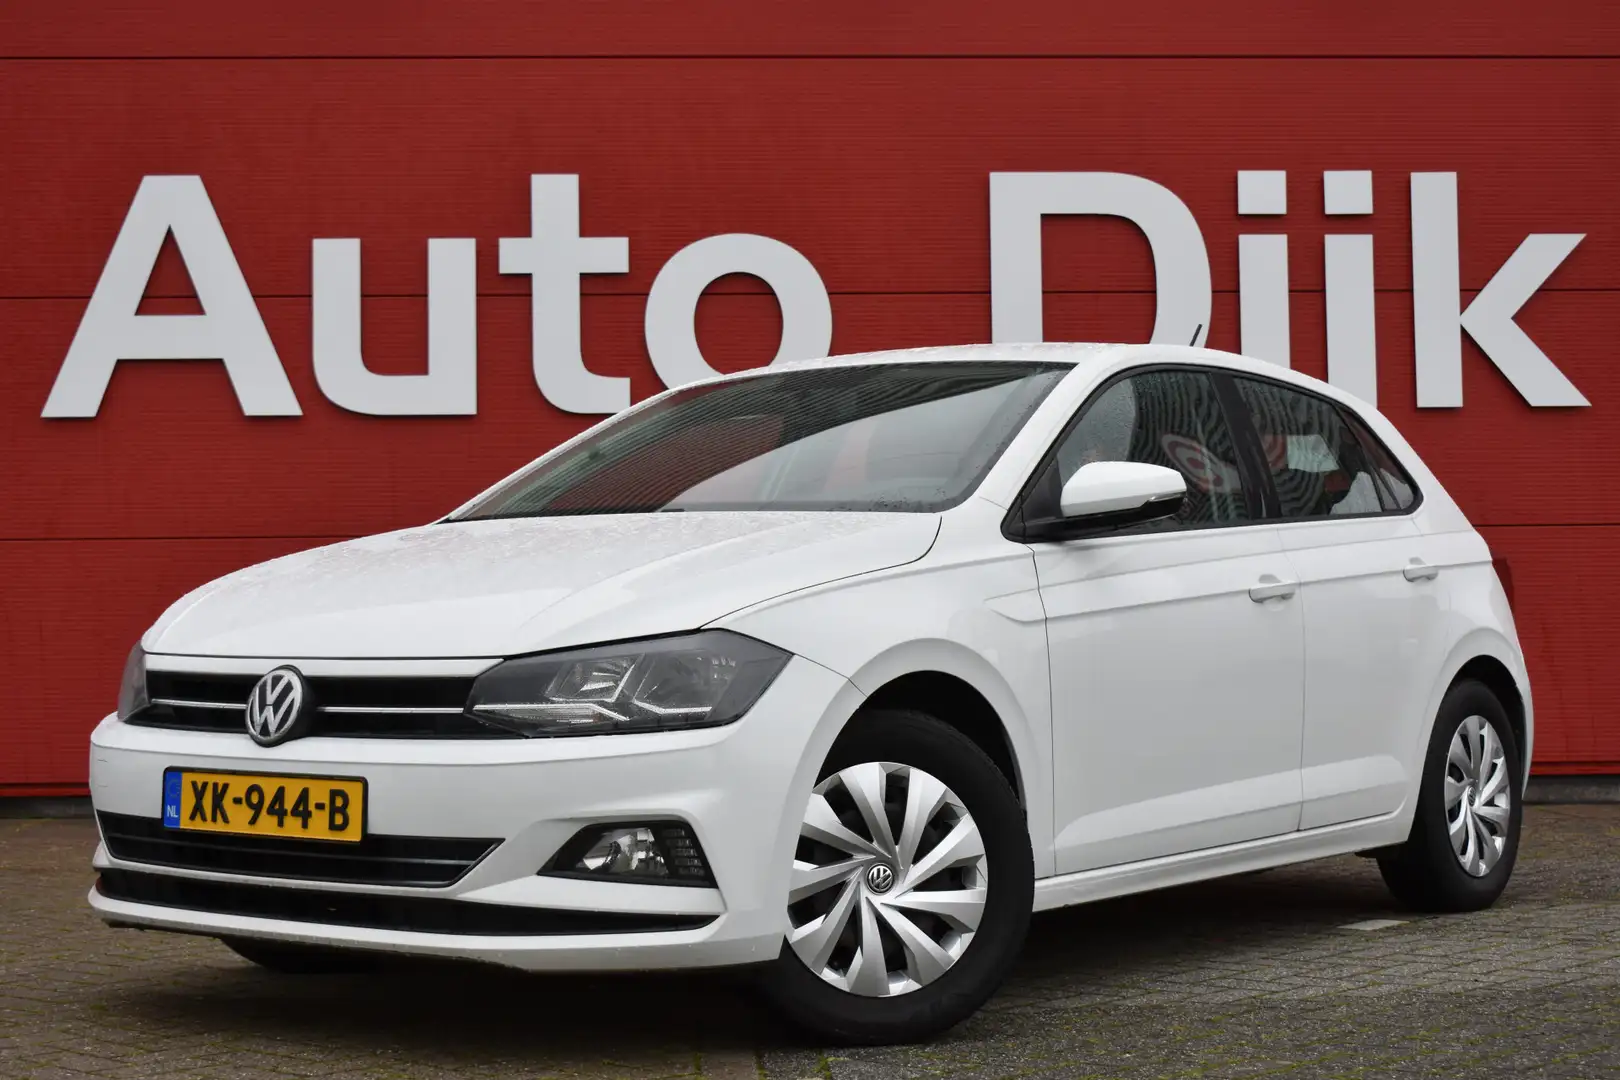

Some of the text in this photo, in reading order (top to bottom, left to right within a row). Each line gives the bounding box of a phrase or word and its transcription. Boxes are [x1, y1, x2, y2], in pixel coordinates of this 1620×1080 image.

[40, 173, 833, 418] Auto
[247, 668, 303, 742] VW
[166, 805, 179, 818] NL
[189, 780, 350, 832] XK-944-B
